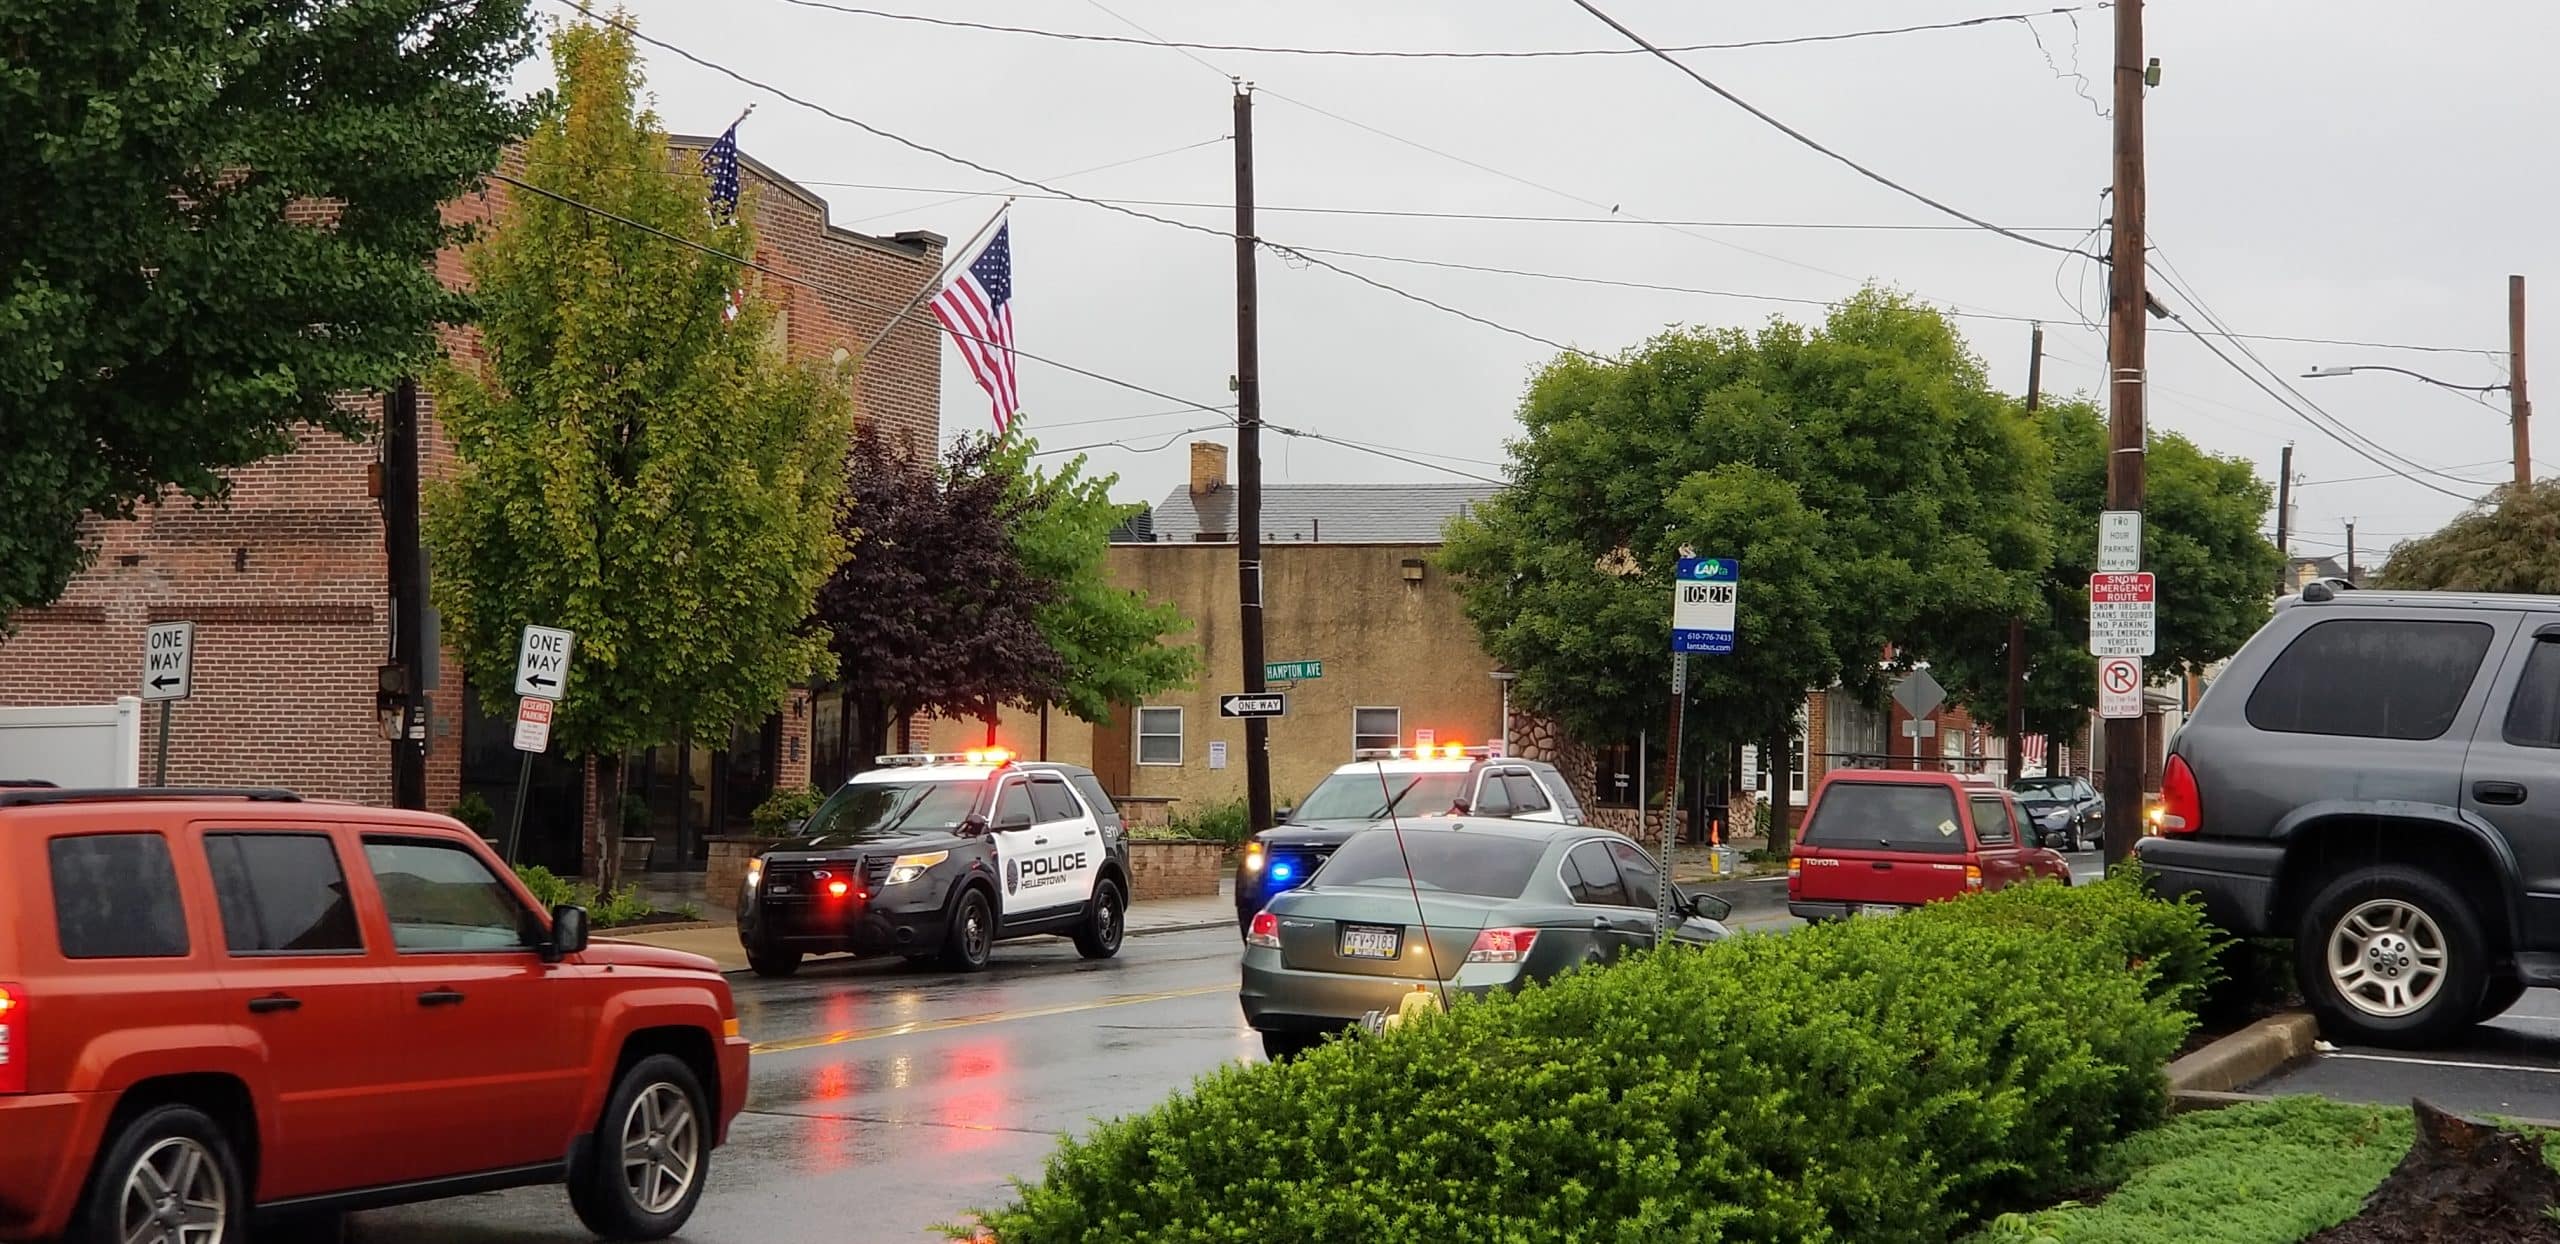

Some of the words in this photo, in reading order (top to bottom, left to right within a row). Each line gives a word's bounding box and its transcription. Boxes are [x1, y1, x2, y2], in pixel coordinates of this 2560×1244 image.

[2113, 518, 2128, 526] TWO
[2110, 531, 2130, 540] HOUR
[2104, 545, 2135, 553] PARKING
[2107, 575, 2139, 584] SNOW
[2094, 584, 2151, 593] EMERGENCY
[1685, 586, 1707, 603] 105
[1710, 586, 1733, 603] 215
[2107, 593, 2139, 601] ROUTE
[2094, 603, 2114, 611] SNOW
[2092, 611, 2117, 619] CHAINS
[2121, 611, 2153, 619] REQUIRED
[2097, 621, 2108, 629] NO
[2112, 621, 2149, 629] PARKING
[151, 630, 183, 649] ONE
[529, 634, 563, 653] ONE
[2107, 638, 2138, 646] VEHICLES
[1686, 642, 1731, 651] lantabus.com
[150, 652, 183, 671] WAY
[527, 653, 562, 672] WAY
[1266, 666, 1303, 681] HAMPTON
[1306, 662, 1321, 677] AVE
[1238, 701, 1256, 711] ONE
[1259, 700, 1280, 711] WAY
[1020, 852, 1087, 878] POLICE
[1804, 858, 1840, 867] TOYOTA
[1020, 874, 1067, 890] HELLERTOWN
